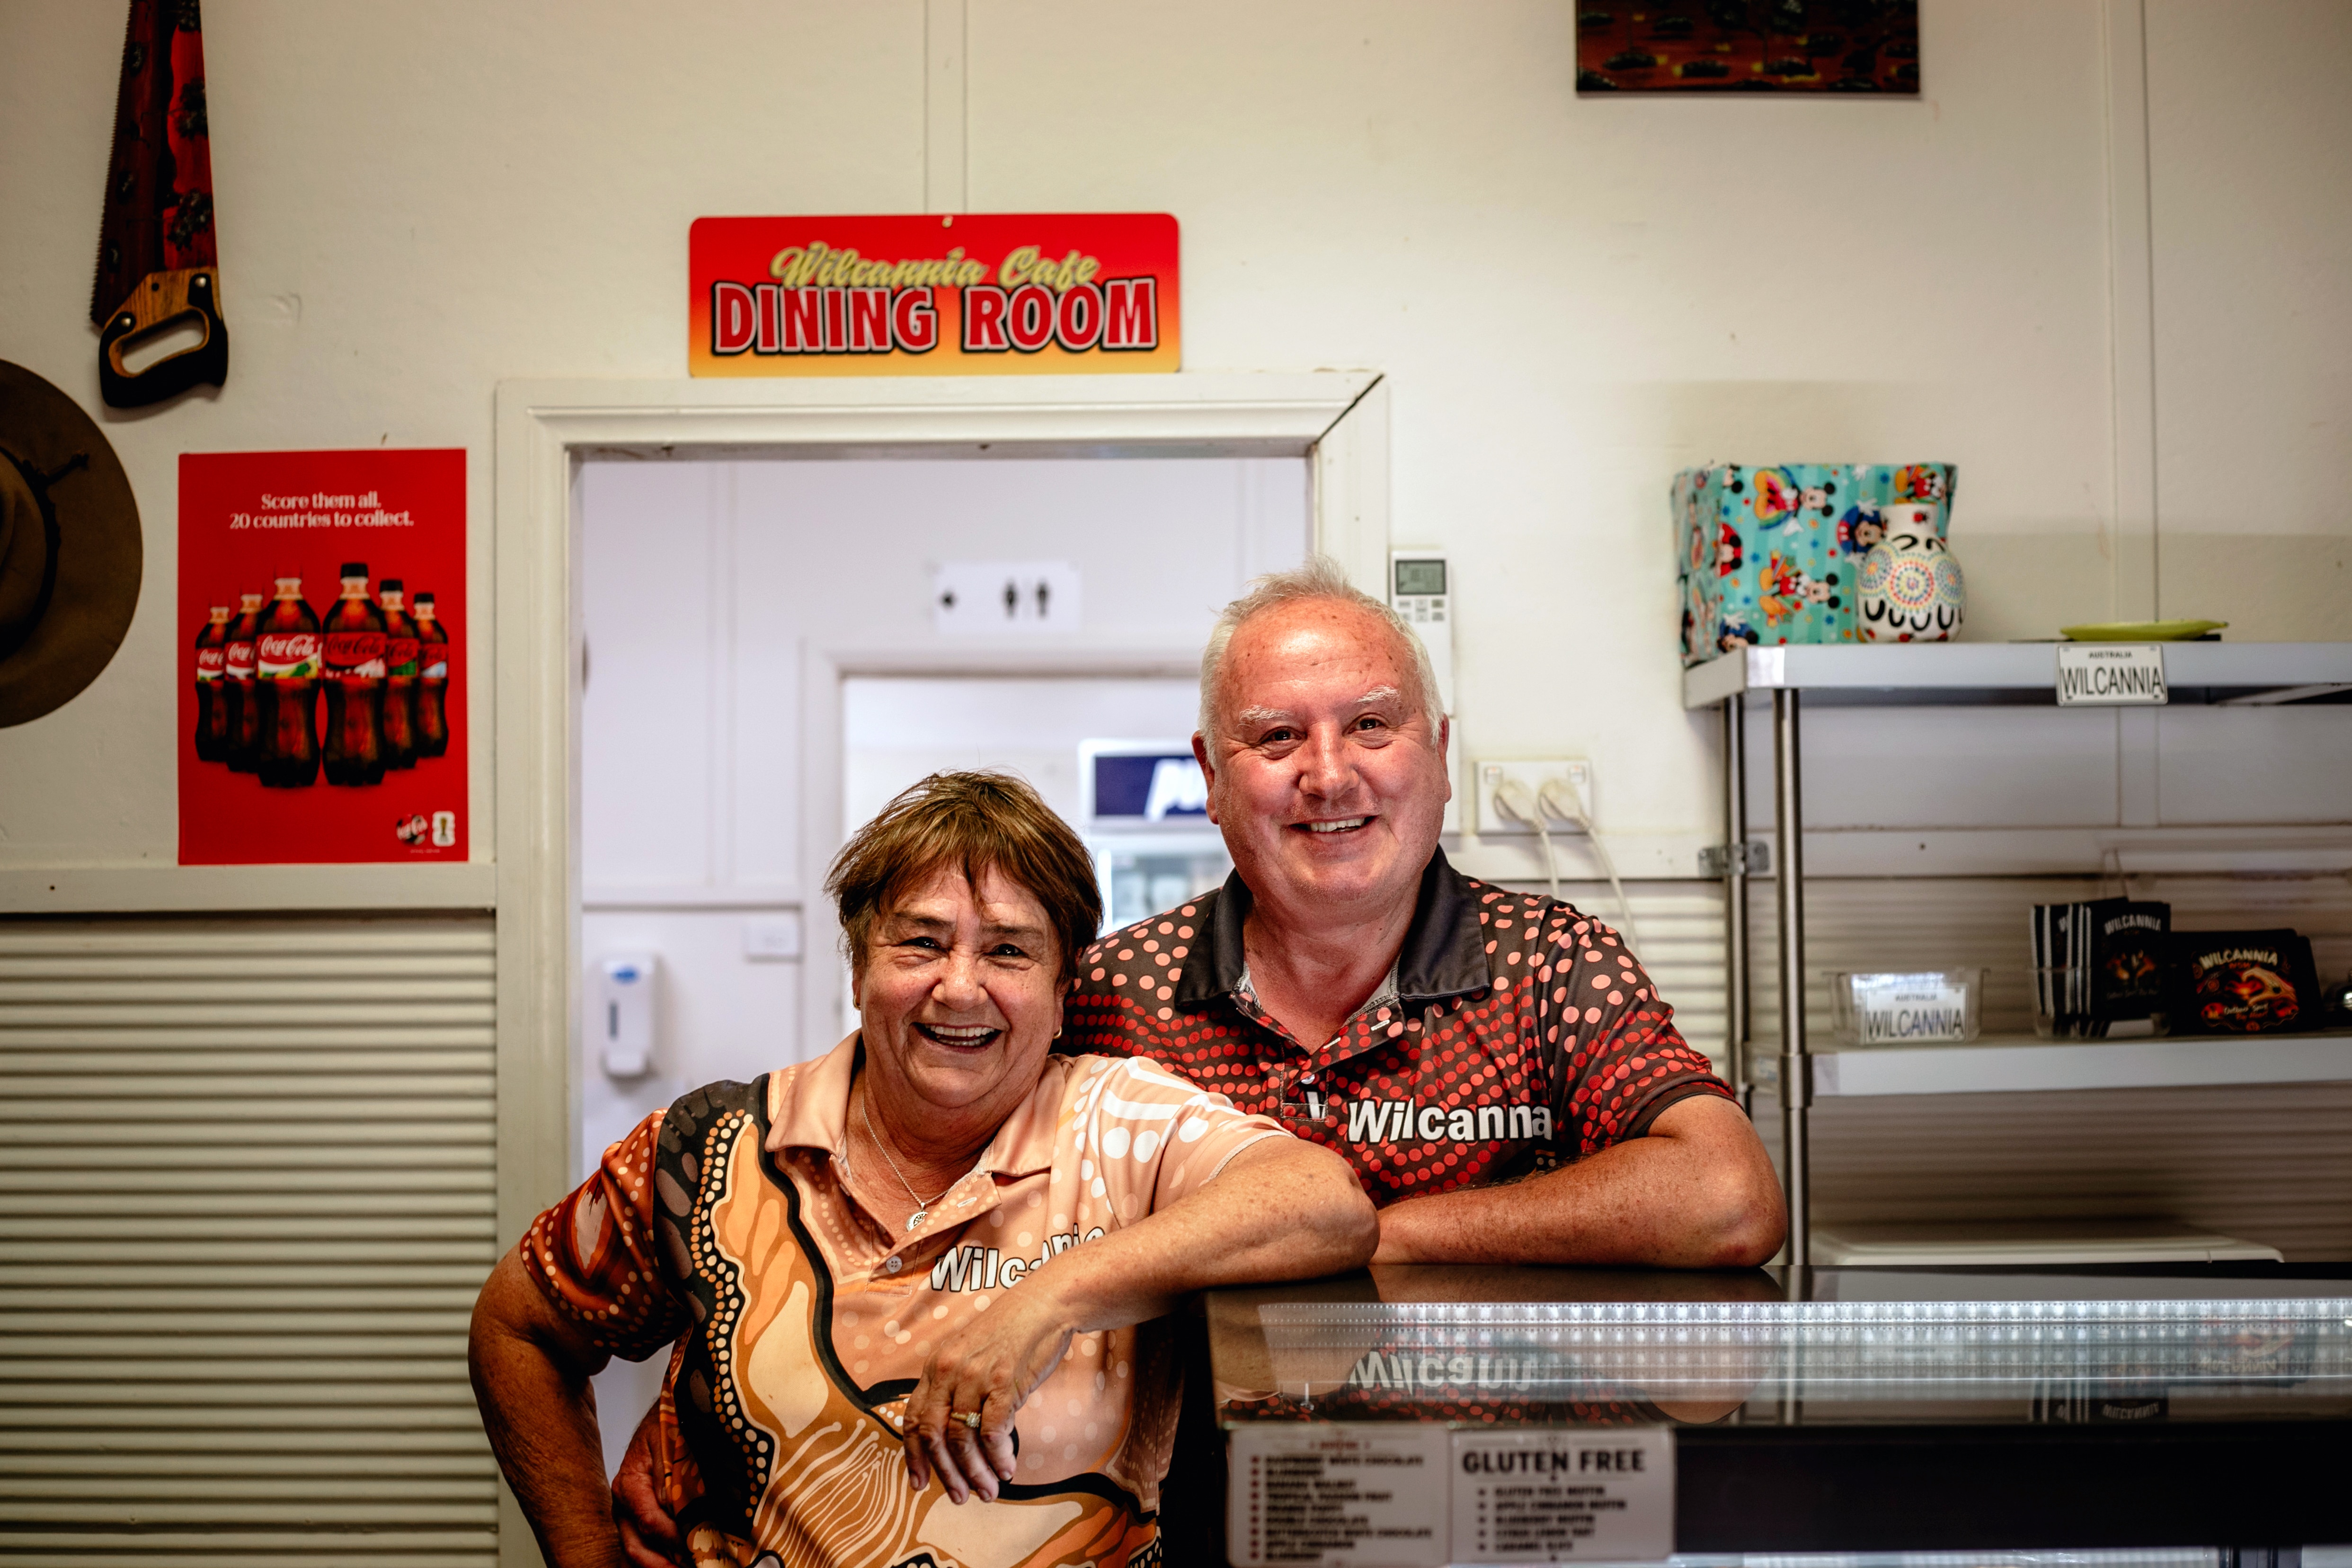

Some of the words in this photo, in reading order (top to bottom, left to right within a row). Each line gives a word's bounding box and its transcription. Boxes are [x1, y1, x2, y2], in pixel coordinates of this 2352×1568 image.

[770, 241, 986, 288] Wilcannia
[999, 245, 1100, 291] Cafe
[712, 281, 937, 355] DINING
[962, 278, 1158, 352] ROOM
[261, 493, 309, 510] Score
[311, 491, 355, 509] them
[358, 490, 381, 509] all.
[230, 513, 250, 530] 20
[253, 511, 331, 529] countries
[334, 511, 351, 527] to
[354, 510, 414, 527] collect.
[2088, 651, 2133, 659] AUSTRALIA
[2062, 666, 2164, 695] WILCANNIA
[2104, 914, 2161, 936] WILCANNIA
[2199, 948, 2278, 970] WILCANNIA
[1867, 1010, 1964, 1037] WILCANNIA
[1462, 1449, 1568, 1474] GLUTEN
[1580, 1449, 1646, 1472] FREE
